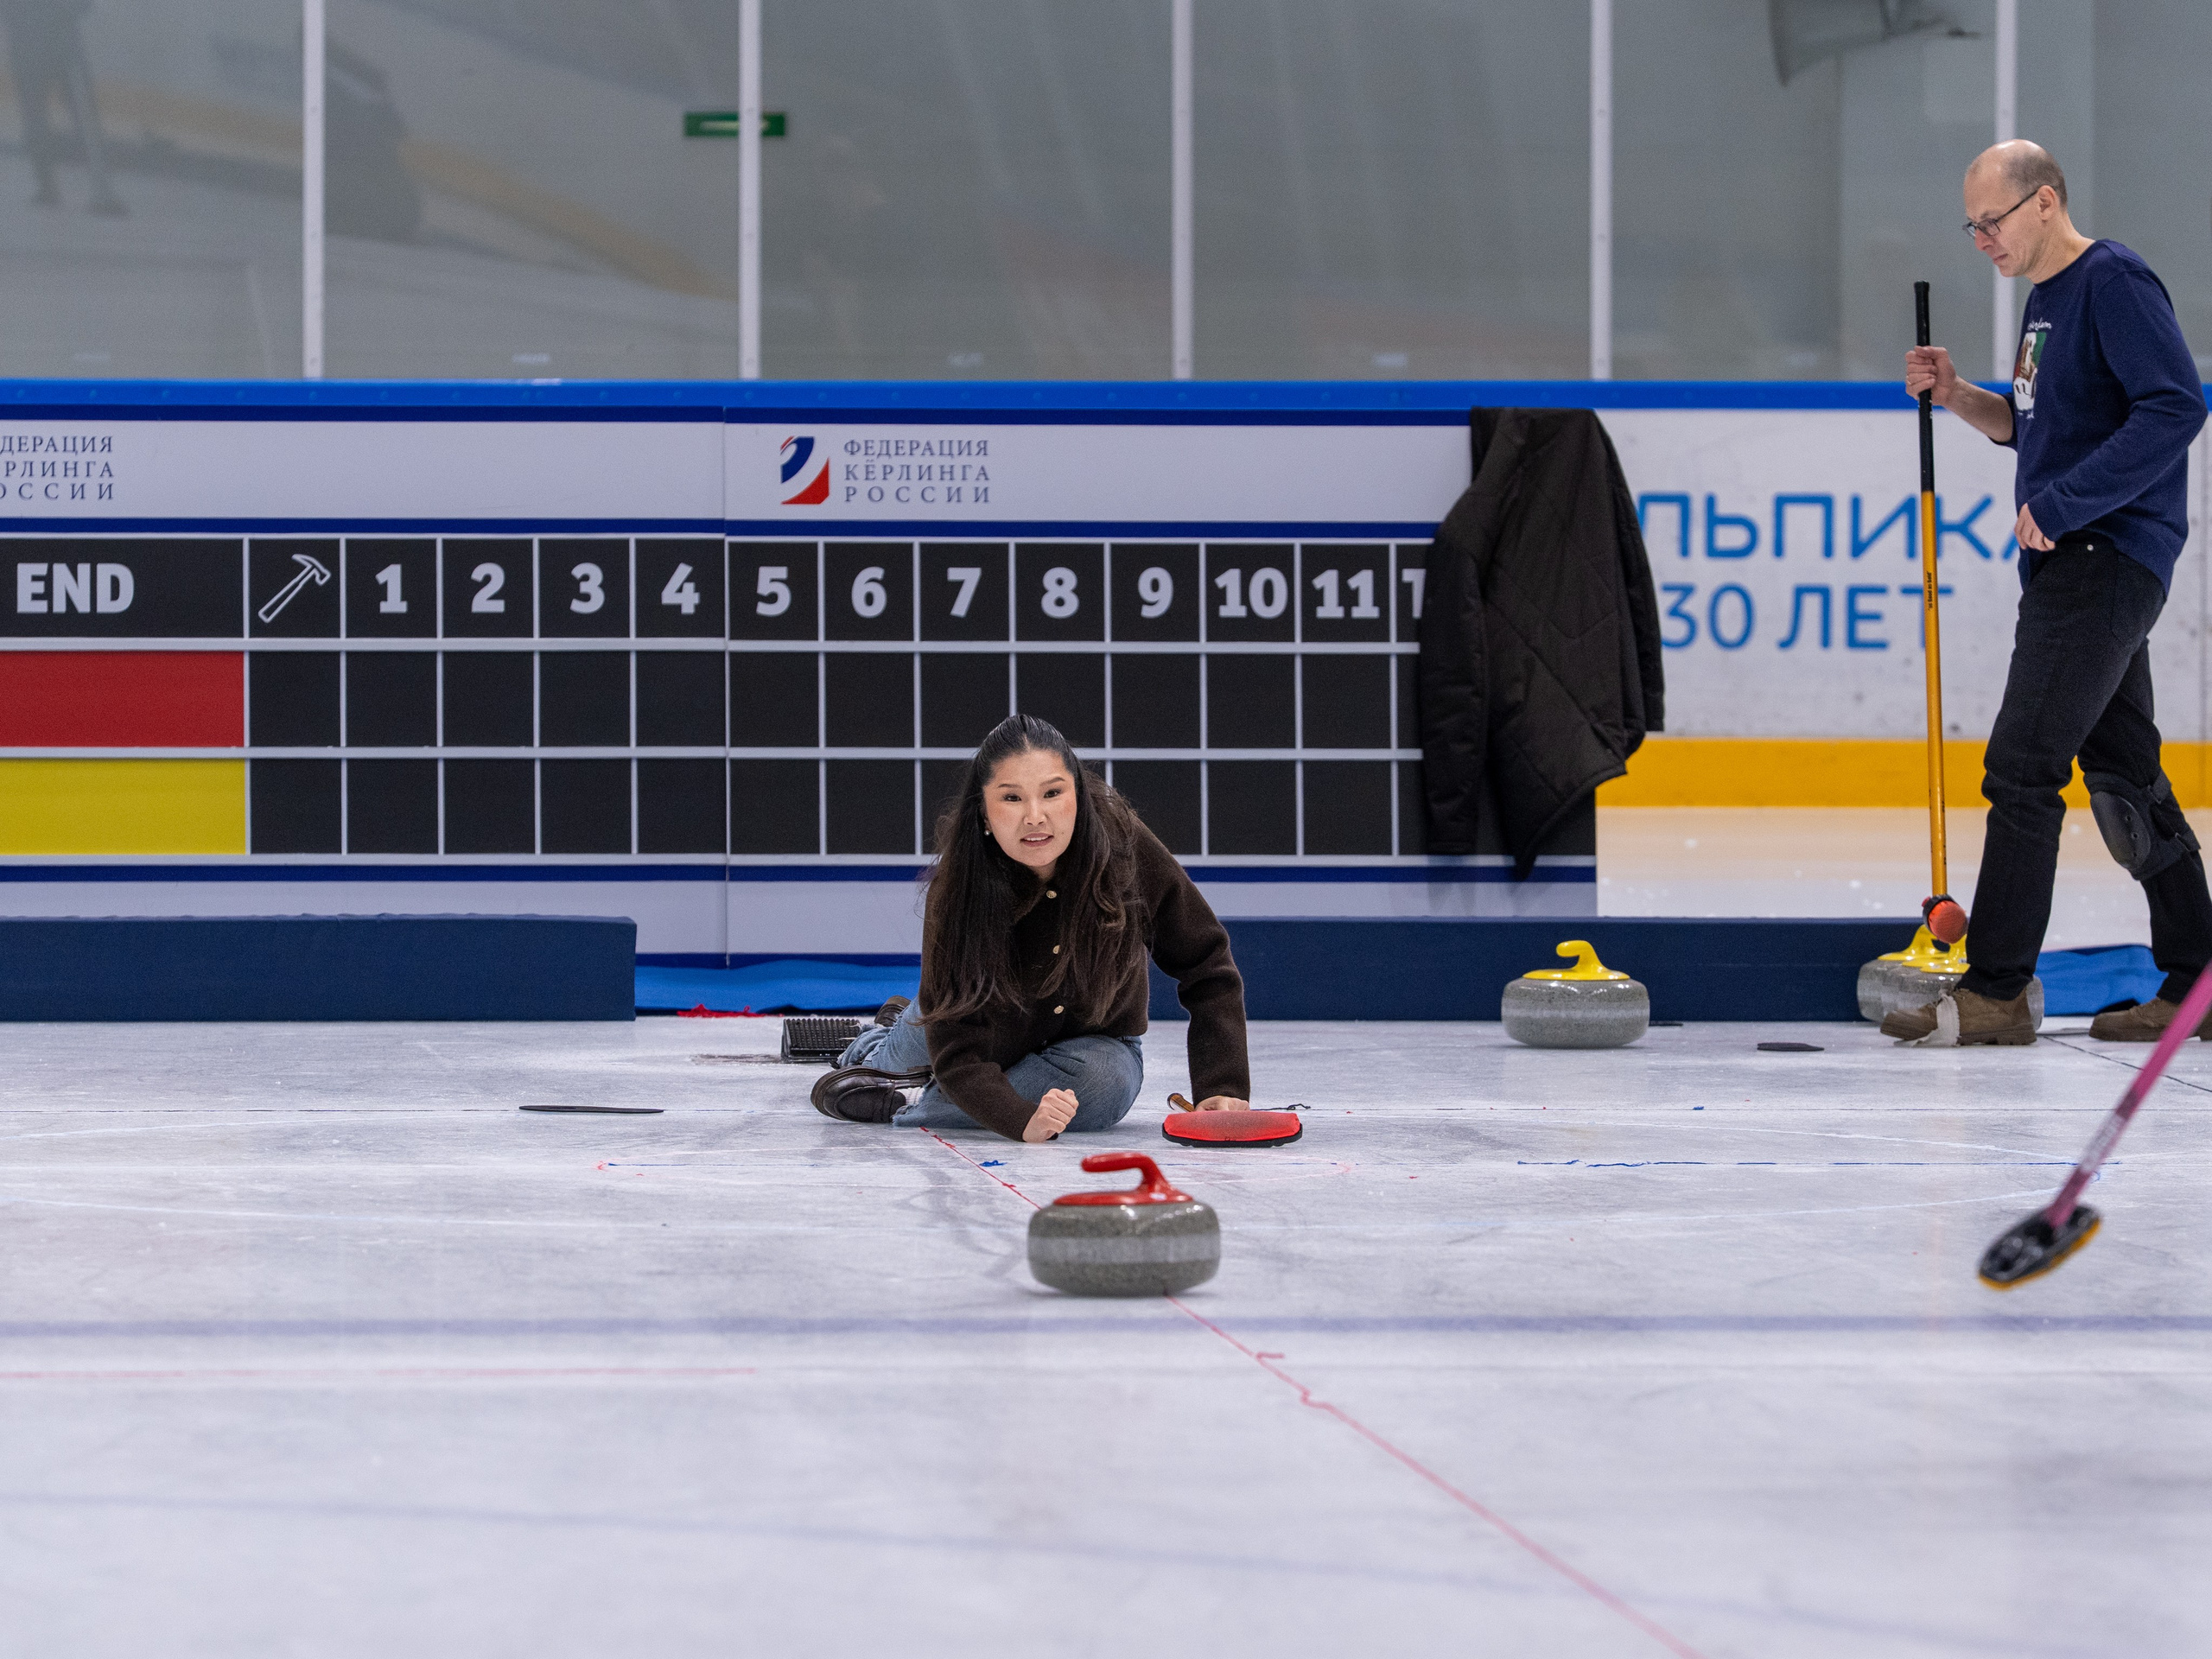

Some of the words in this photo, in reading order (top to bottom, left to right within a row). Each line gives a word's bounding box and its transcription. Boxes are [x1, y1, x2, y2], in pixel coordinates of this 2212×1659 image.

[843, 439, 989, 458] ФЕДЕРАЦИЯ
[4, 461, 114, 478] РЛИНГА
[843, 461, 990, 481] КЁРЛИНГА
[844, 486, 990, 504] РОССИИ
[1637, 493, 2020, 560] ЛЬПИК
[16, 563, 135, 614] END
[375, 564, 409, 613] 1
[471, 563, 506, 613] 2
[570, 563, 605, 614] 3
[661, 563, 701, 615] 4
[756, 566, 792, 617] 5
[851, 567, 887, 619] 6
[947, 568, 982, 618] 7
[1040, 567, 1080, 620] 8
[1137, 567, 1174, 619] 9
[1214, 568, 1288, 619] 10
[1312, 569, 1381, 620] 11
[1660, 582, 1756, 651] 30
[1777, 584, 1955, 651] ЛЕТ
